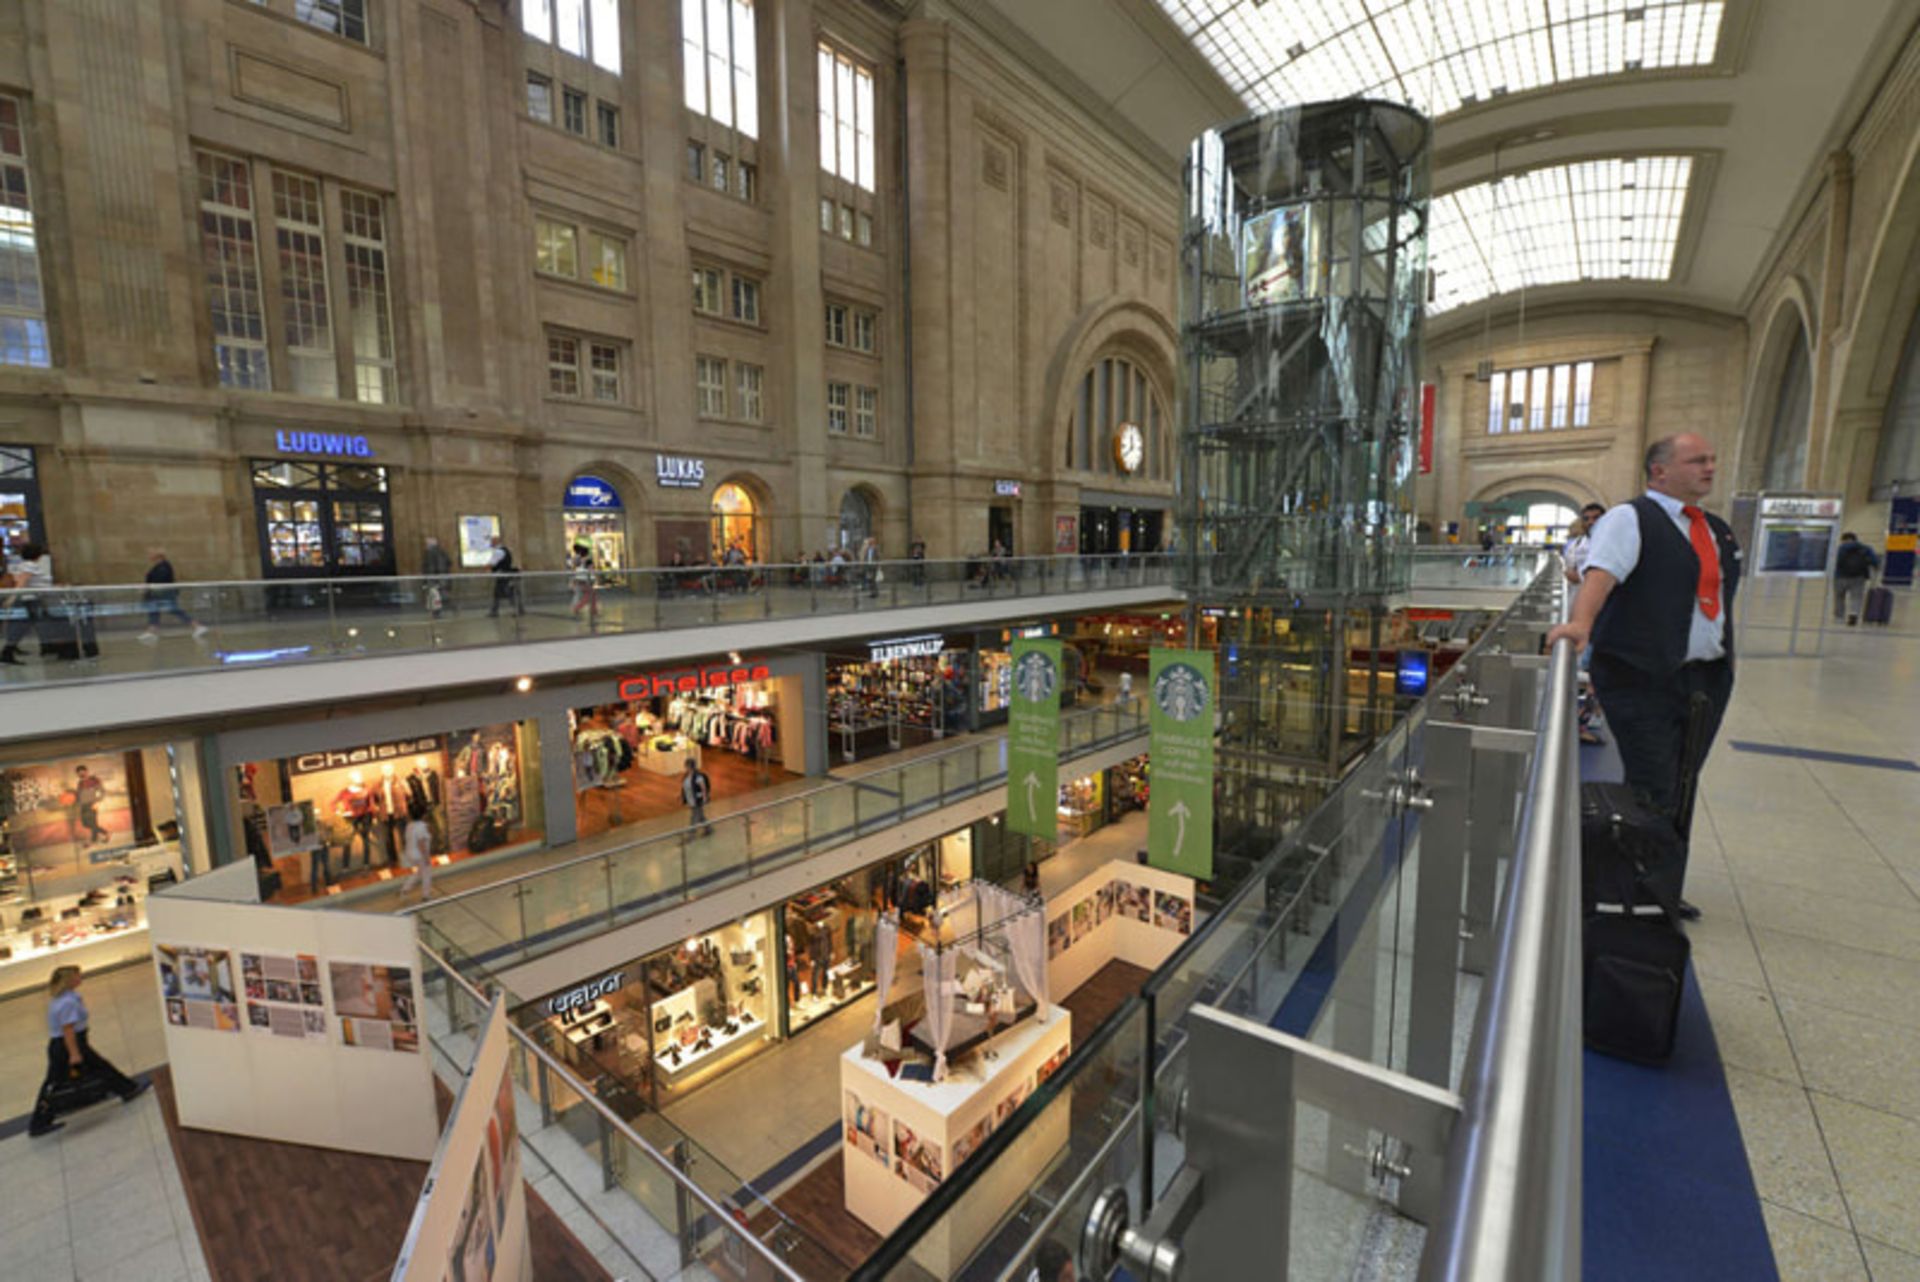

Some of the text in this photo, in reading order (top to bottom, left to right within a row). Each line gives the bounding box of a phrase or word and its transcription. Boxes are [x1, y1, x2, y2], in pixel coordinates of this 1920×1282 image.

[656, 453, 704, 480] LUKAS
[619, 665, 769, 700] Chelsea
[297, 738, 436, 772] Chelsea
